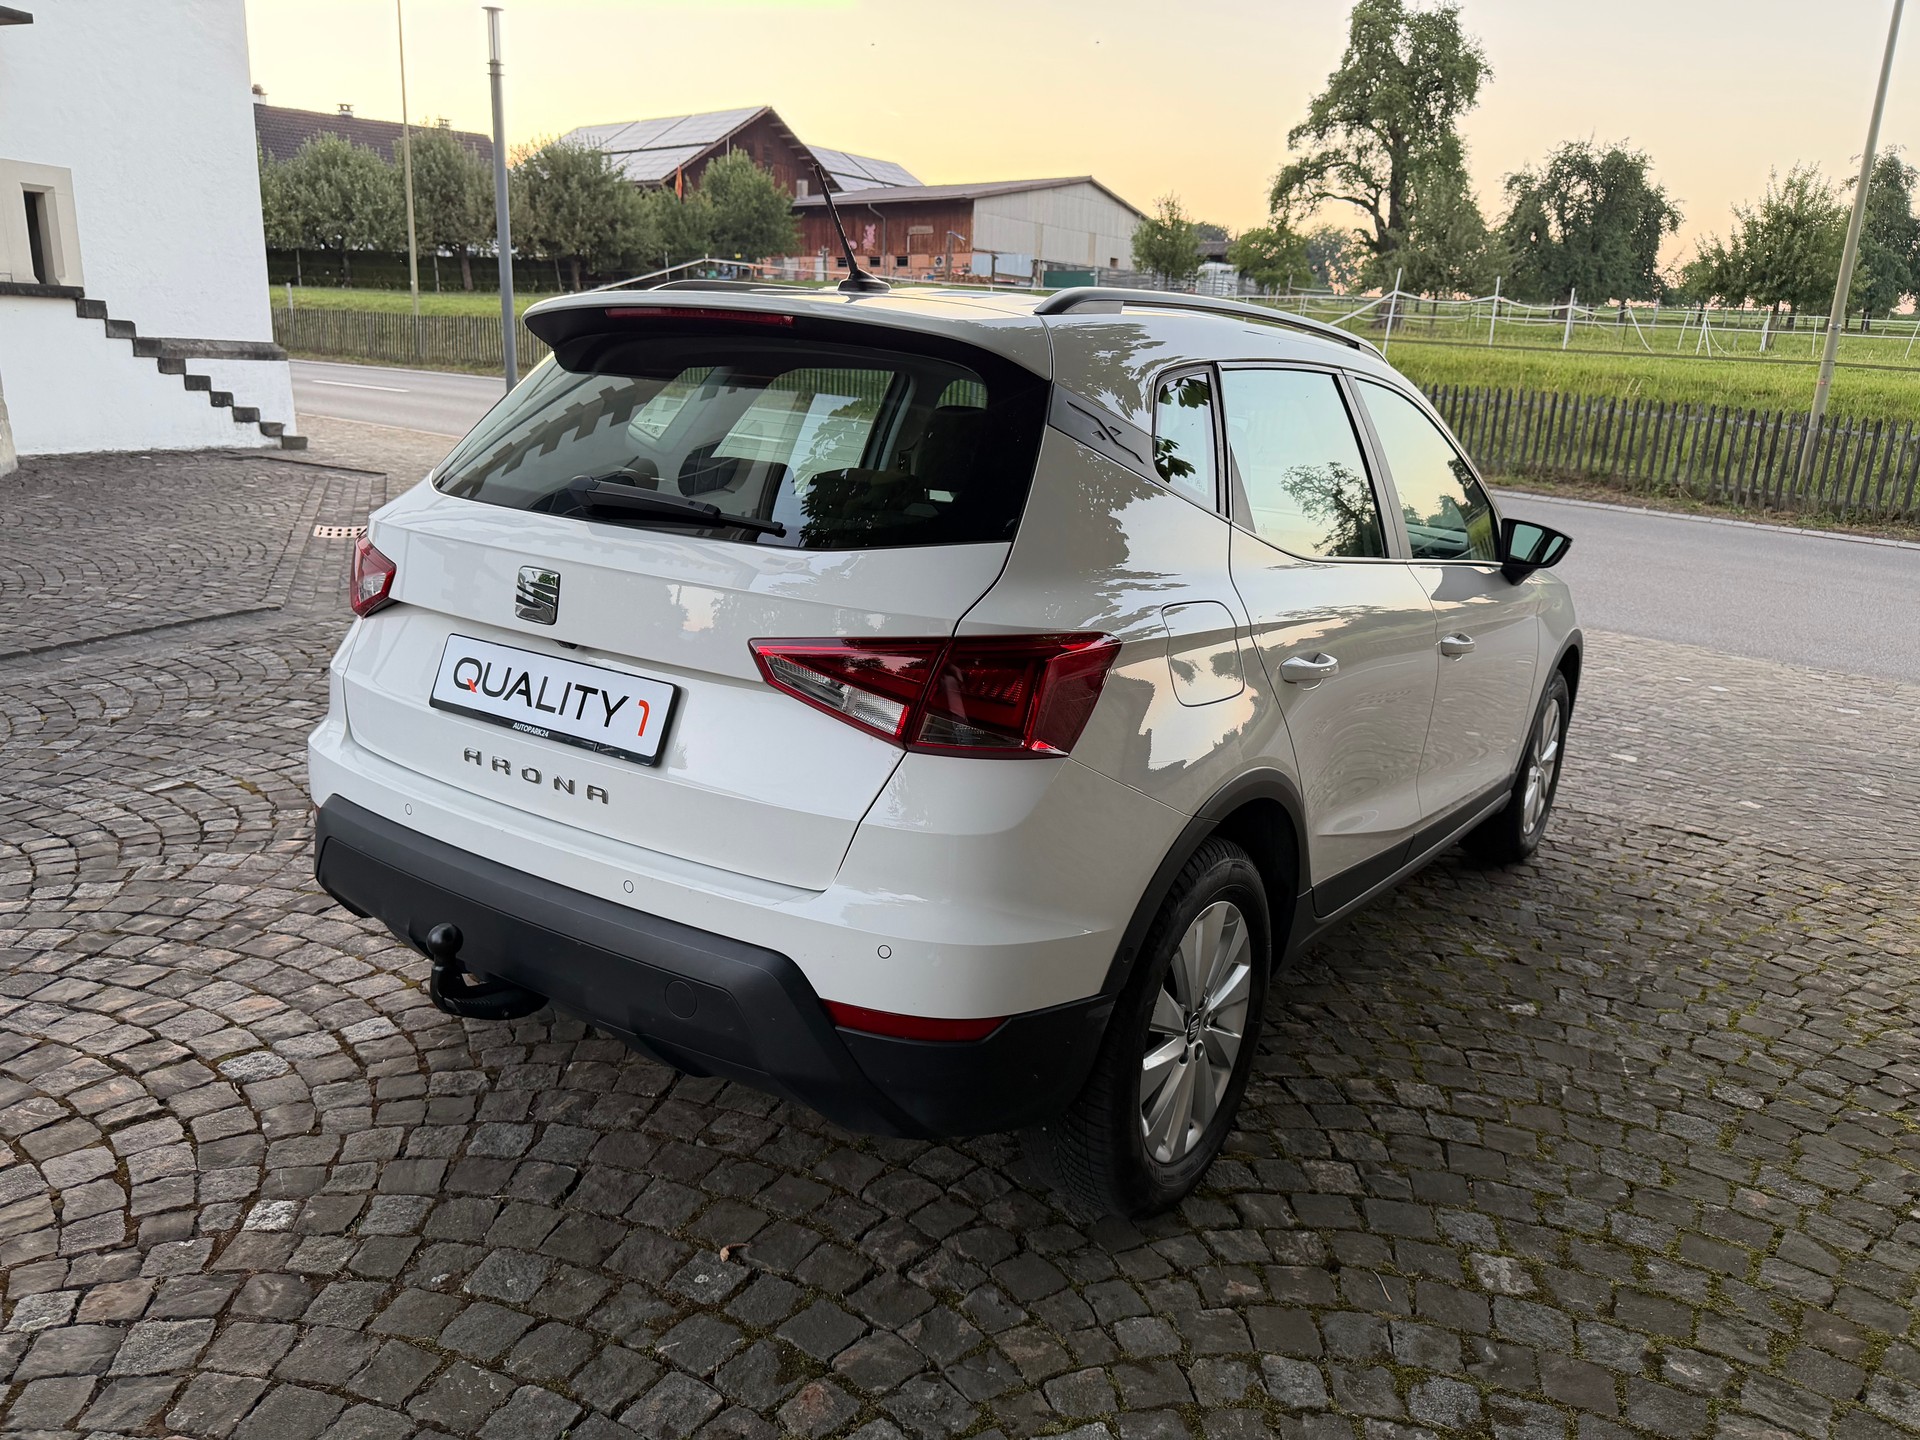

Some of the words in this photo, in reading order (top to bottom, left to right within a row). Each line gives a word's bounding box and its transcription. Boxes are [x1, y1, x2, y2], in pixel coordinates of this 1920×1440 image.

[453, 656, 630, 728] QUALITY
[637, 699, 650, 737] 1
[512, 722, 549, 738] AUTOPARK24
[463, 747, 609, 805] ARONA
